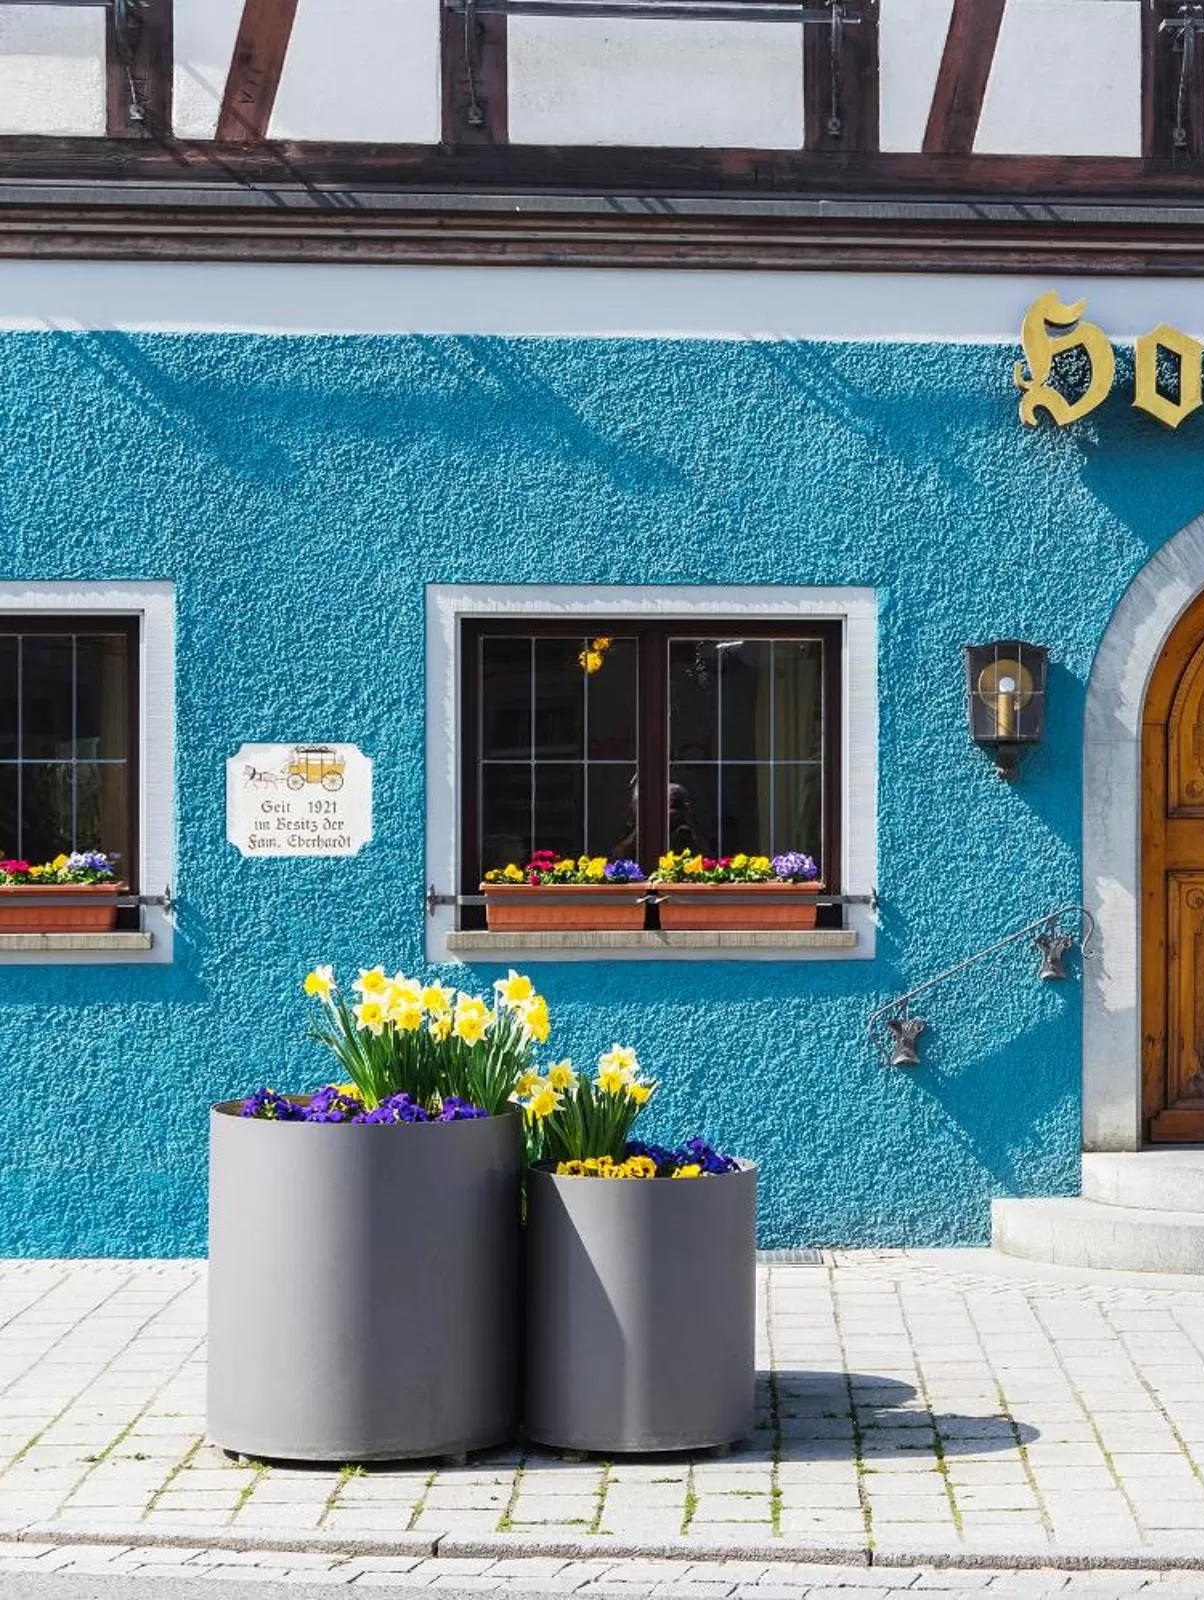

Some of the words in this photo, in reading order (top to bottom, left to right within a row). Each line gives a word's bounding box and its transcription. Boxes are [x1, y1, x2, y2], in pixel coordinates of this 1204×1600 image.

[261, 800, 291, 813] Seit
[309, 800, 337, 813] 1921
[254, 820, 271, 831] im
[276, 817, 318, 832] Besitz
[323, 818, 345, 831] der
[248, 834, 281, 850] Fam.
[287, 834, 351, 850] Eberhardt
